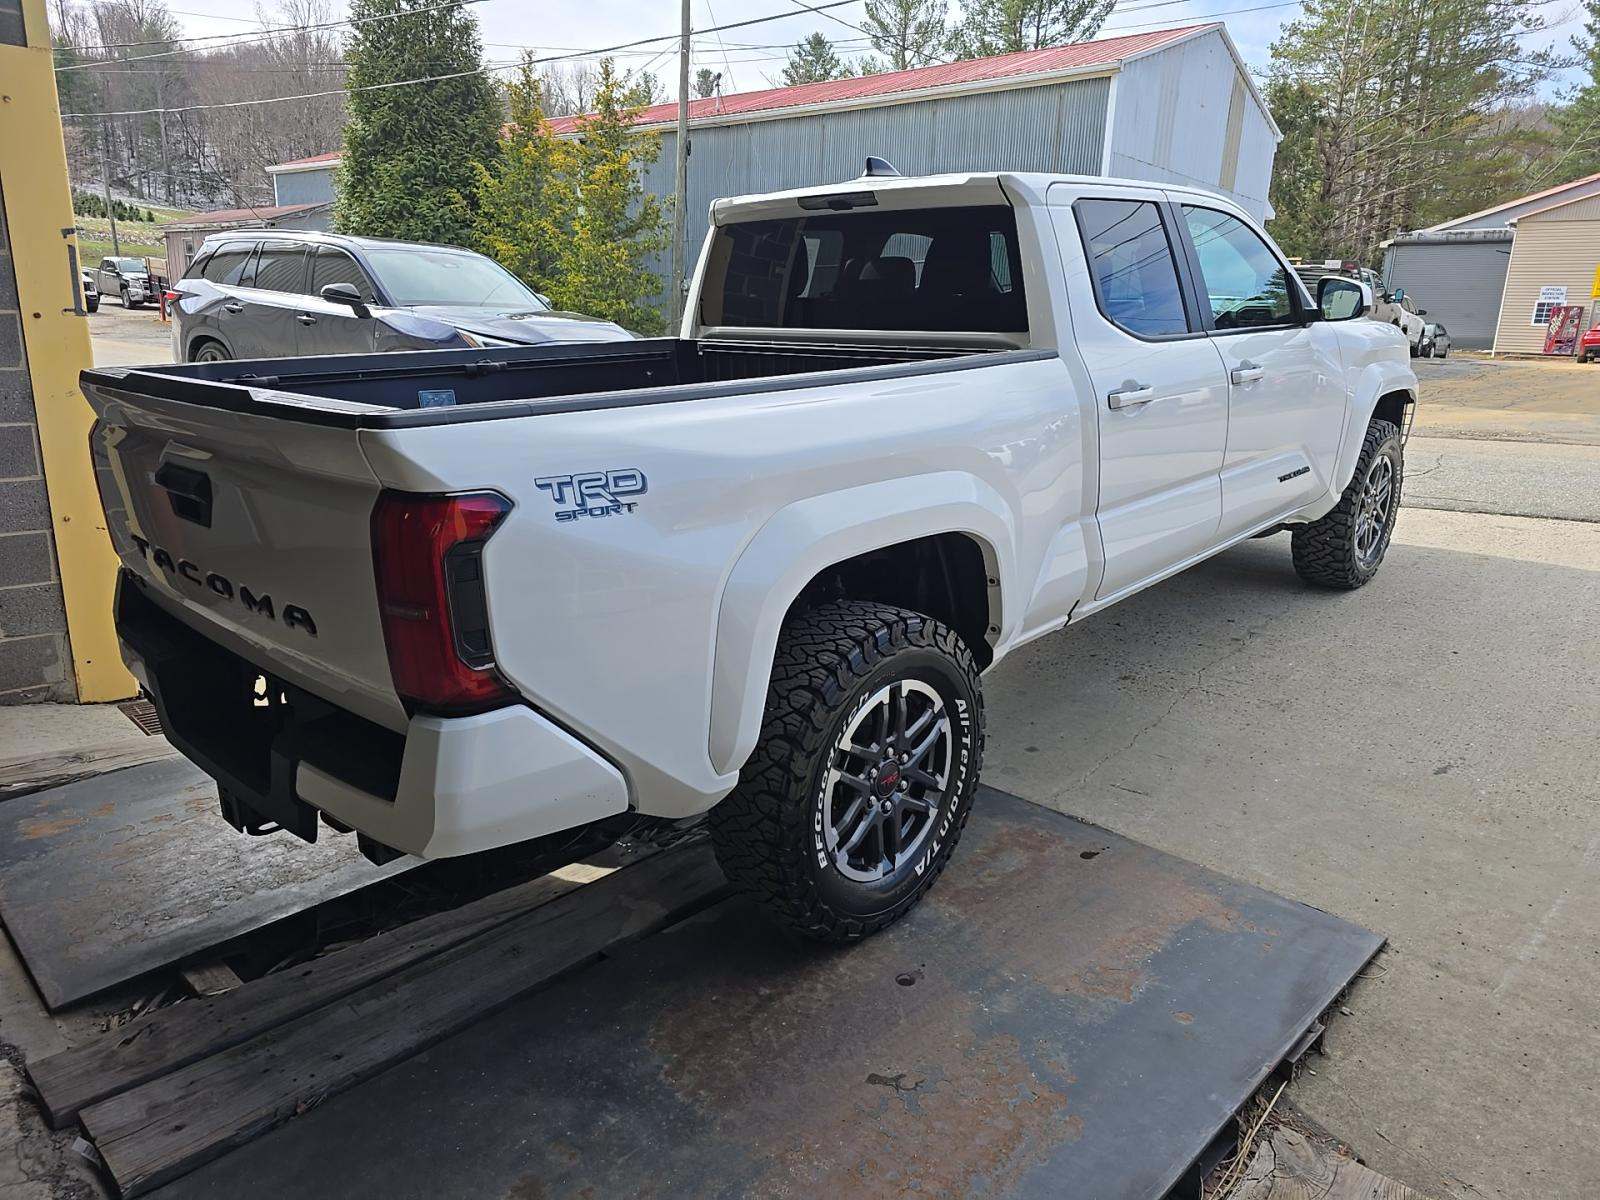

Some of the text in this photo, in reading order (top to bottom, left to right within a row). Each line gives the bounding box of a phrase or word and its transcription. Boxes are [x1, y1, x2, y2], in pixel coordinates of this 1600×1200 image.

[534, 467, 648, 507] TRD
[554, 502, 639, 521] SPORT
[131, 534, 318, 638] TACOMA
[914, 840, 941, 876] T/A
